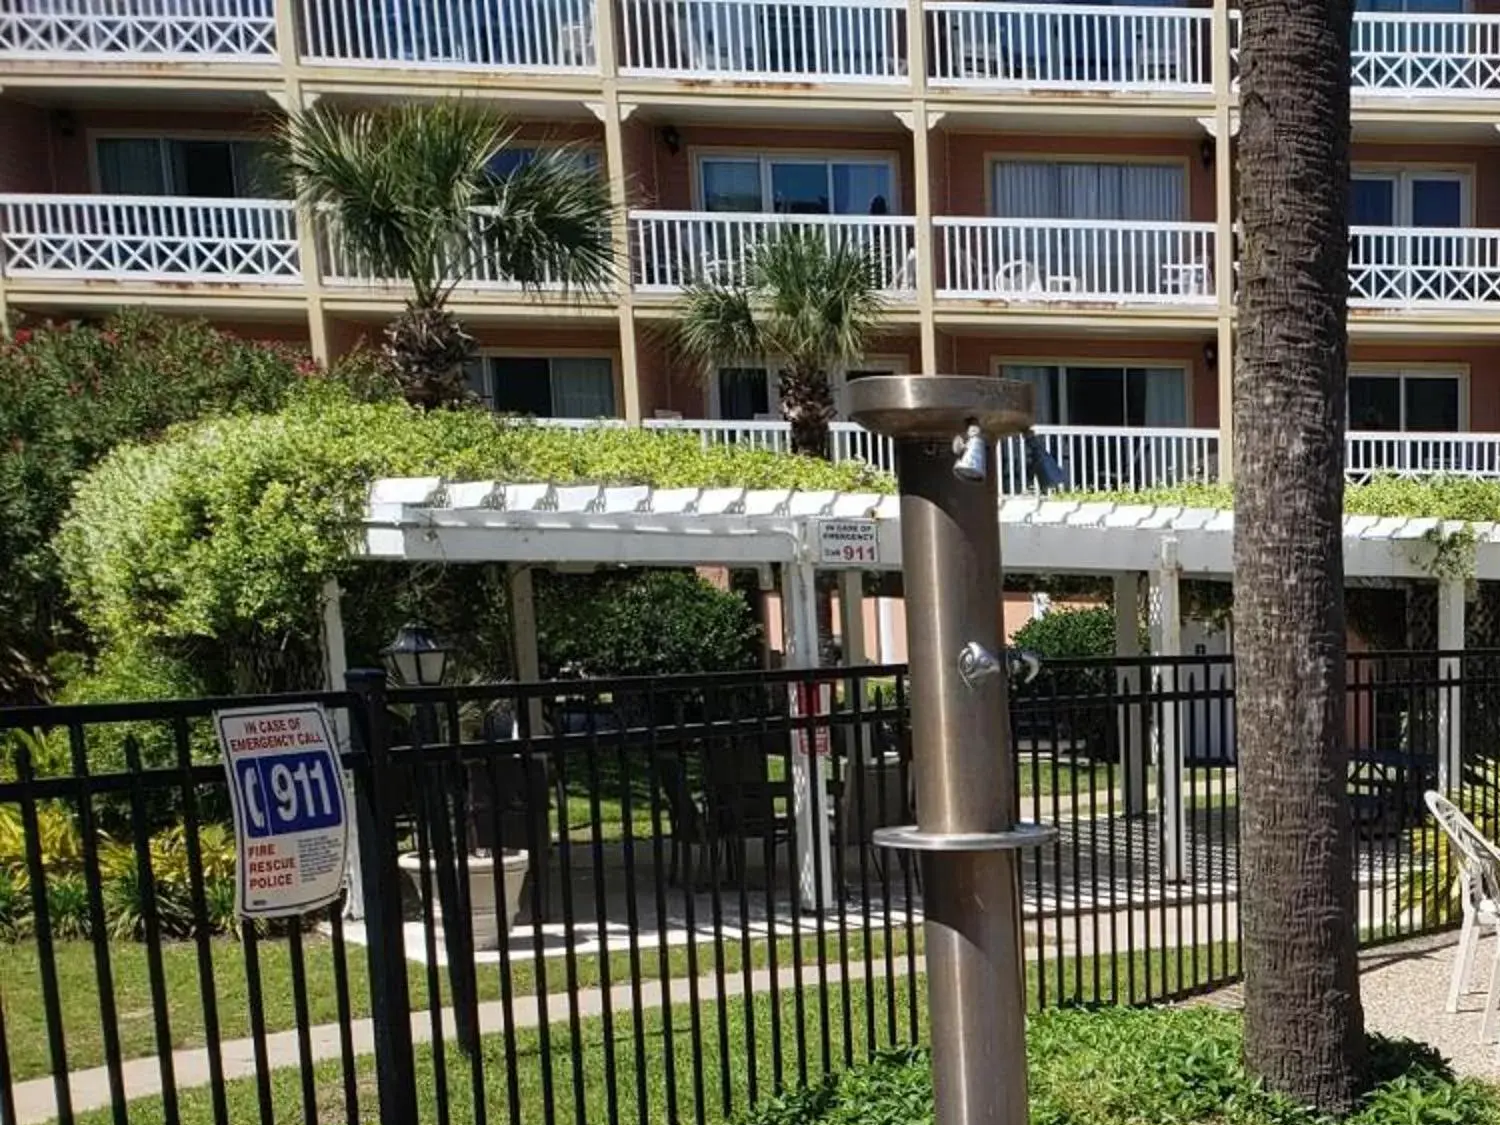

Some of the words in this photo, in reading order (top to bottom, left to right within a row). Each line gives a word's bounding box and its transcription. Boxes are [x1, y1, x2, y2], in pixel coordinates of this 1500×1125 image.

[843, 545, 875, 561] 911
[244, 721, 257, 734] IN
[260, 719, 287, 733] CASE
[288, 717, 300, 730] OF
[230, 735, 295, 752] EMERGENCY
[298, 732, 323, 745] CALL
[271, 760, 332, 822] 911
[248, 843, 276, 858] FIRE
[249, 857, 297, 874] RESCUE
[249, 873, 294, 890] POLICE
